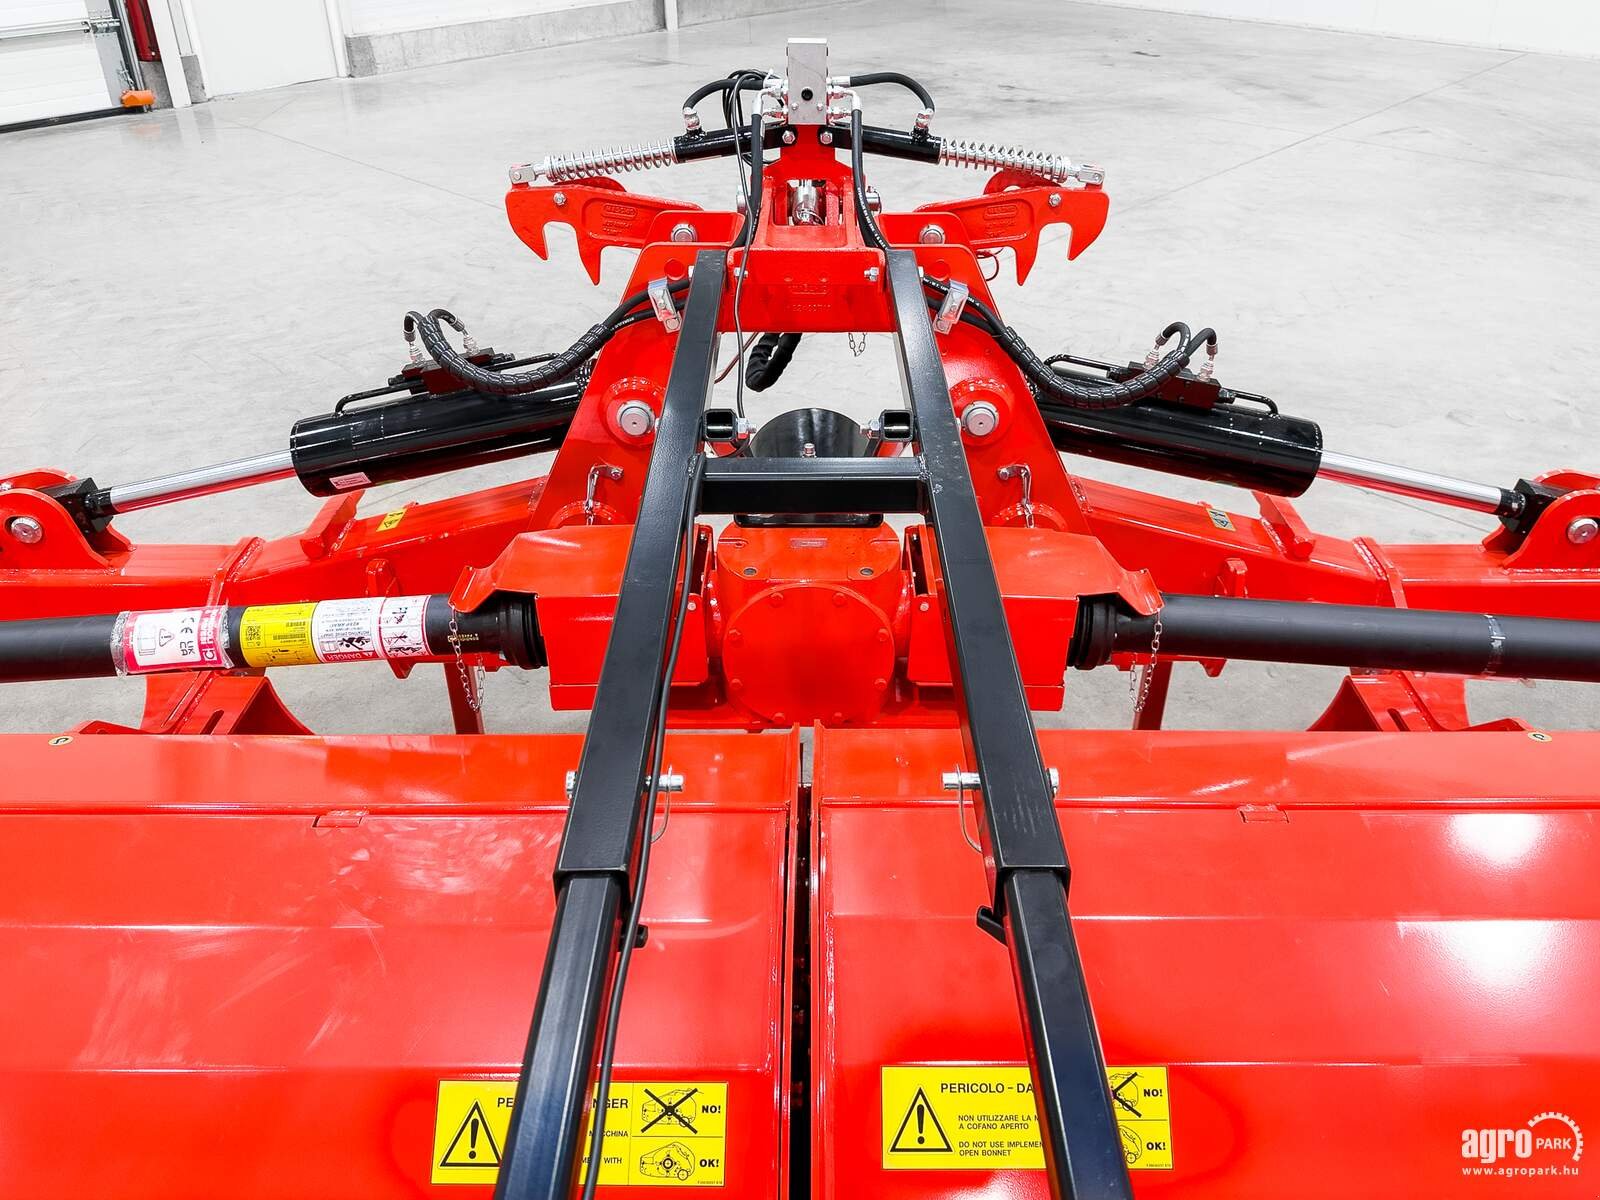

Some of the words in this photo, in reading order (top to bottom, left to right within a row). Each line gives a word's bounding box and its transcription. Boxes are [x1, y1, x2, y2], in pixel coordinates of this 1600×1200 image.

[940, 1083, 1005, 1094] PERICOLO
[1143, 1088, 1163, 1097] NO!
[701, 1105, 721, 1114] NO!
[958, 1114, 974, 1122] NON
[976, 1114, 1019, 1122] UTILIZZARE
[1021, 1114, 1031, 1122] LA
[966, 1122, 998, 1130] COFANO
[1000, 1122, 1029, 1130] APERTO
[1146, 1141, 1166, 1151] OK!
[959, 1149, 979, 1157] OPEN
[981, 1149, 1012, 1157] BONNET
[699, 1159, 719, 1168] OK!
